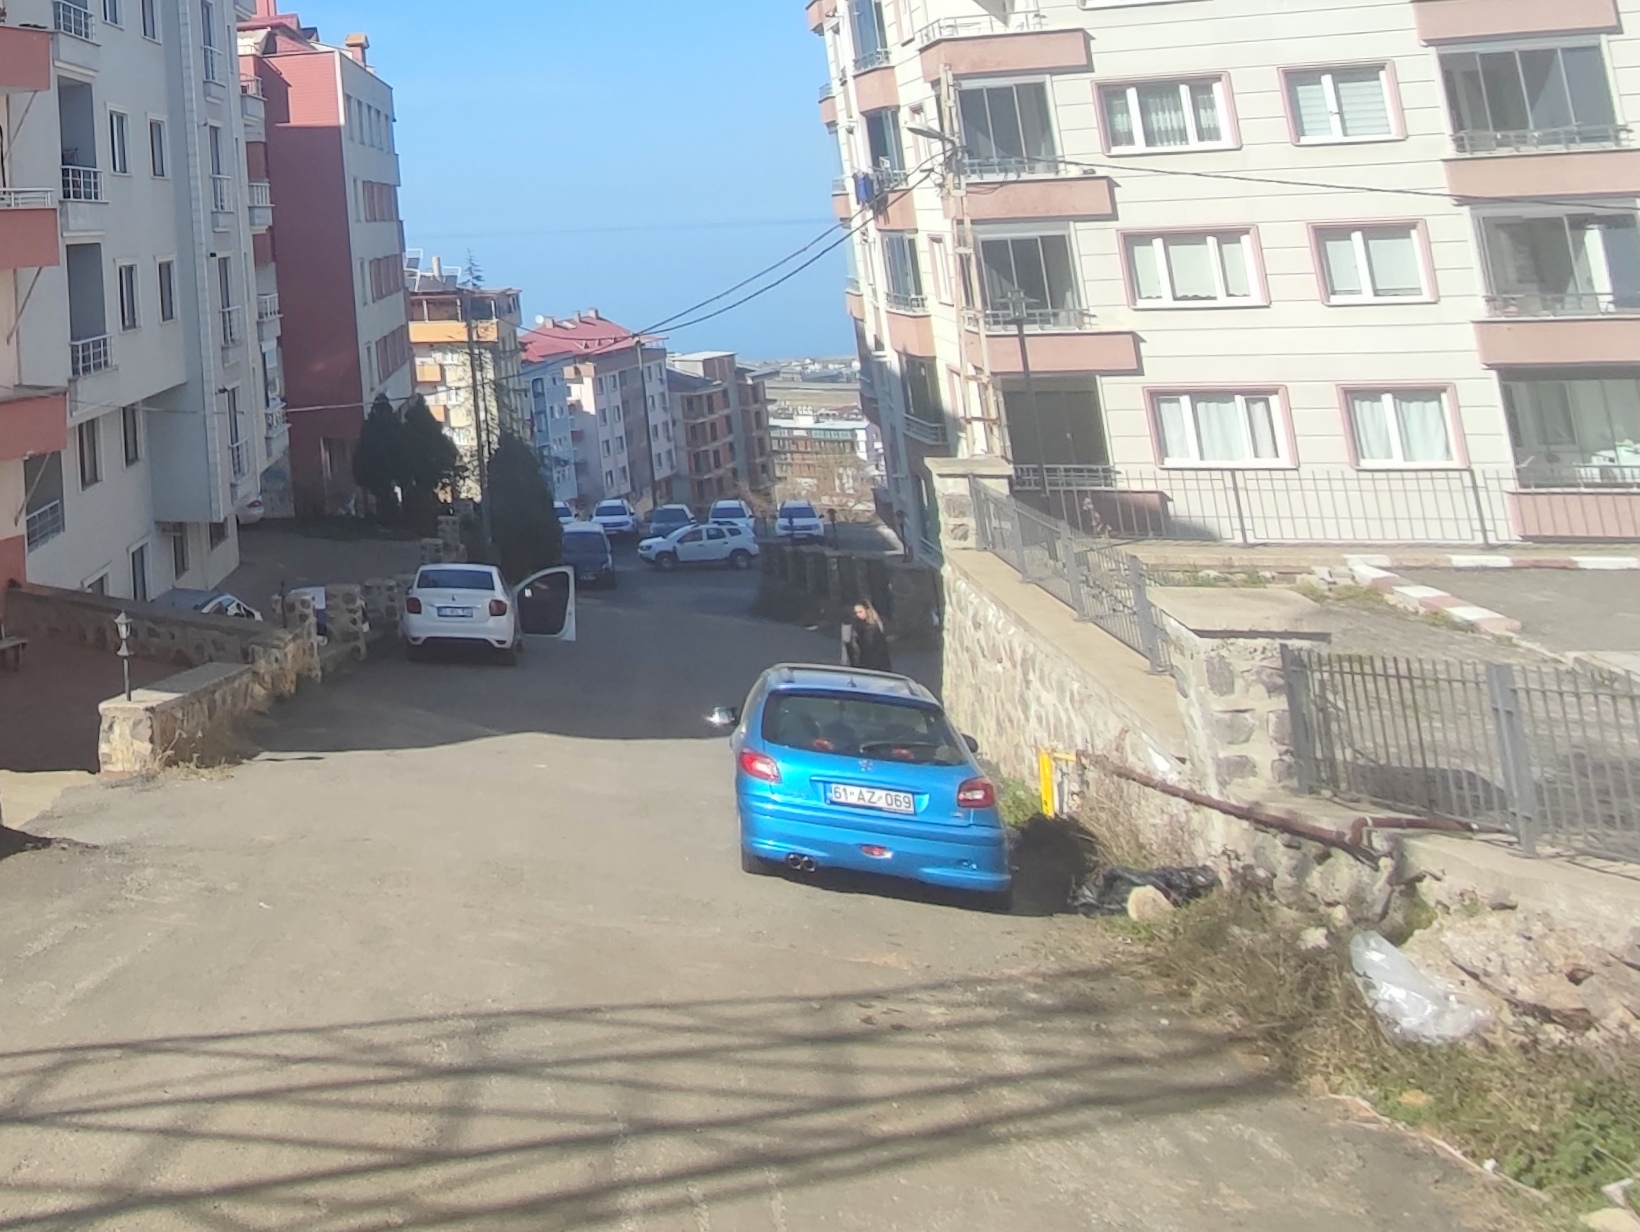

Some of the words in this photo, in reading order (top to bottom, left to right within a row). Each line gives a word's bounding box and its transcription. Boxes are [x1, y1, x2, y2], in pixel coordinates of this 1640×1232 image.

[833, 786, 848, 801] 61
[857, 788, 877, 804] AZ
[885, 792, 912, 809] 069
